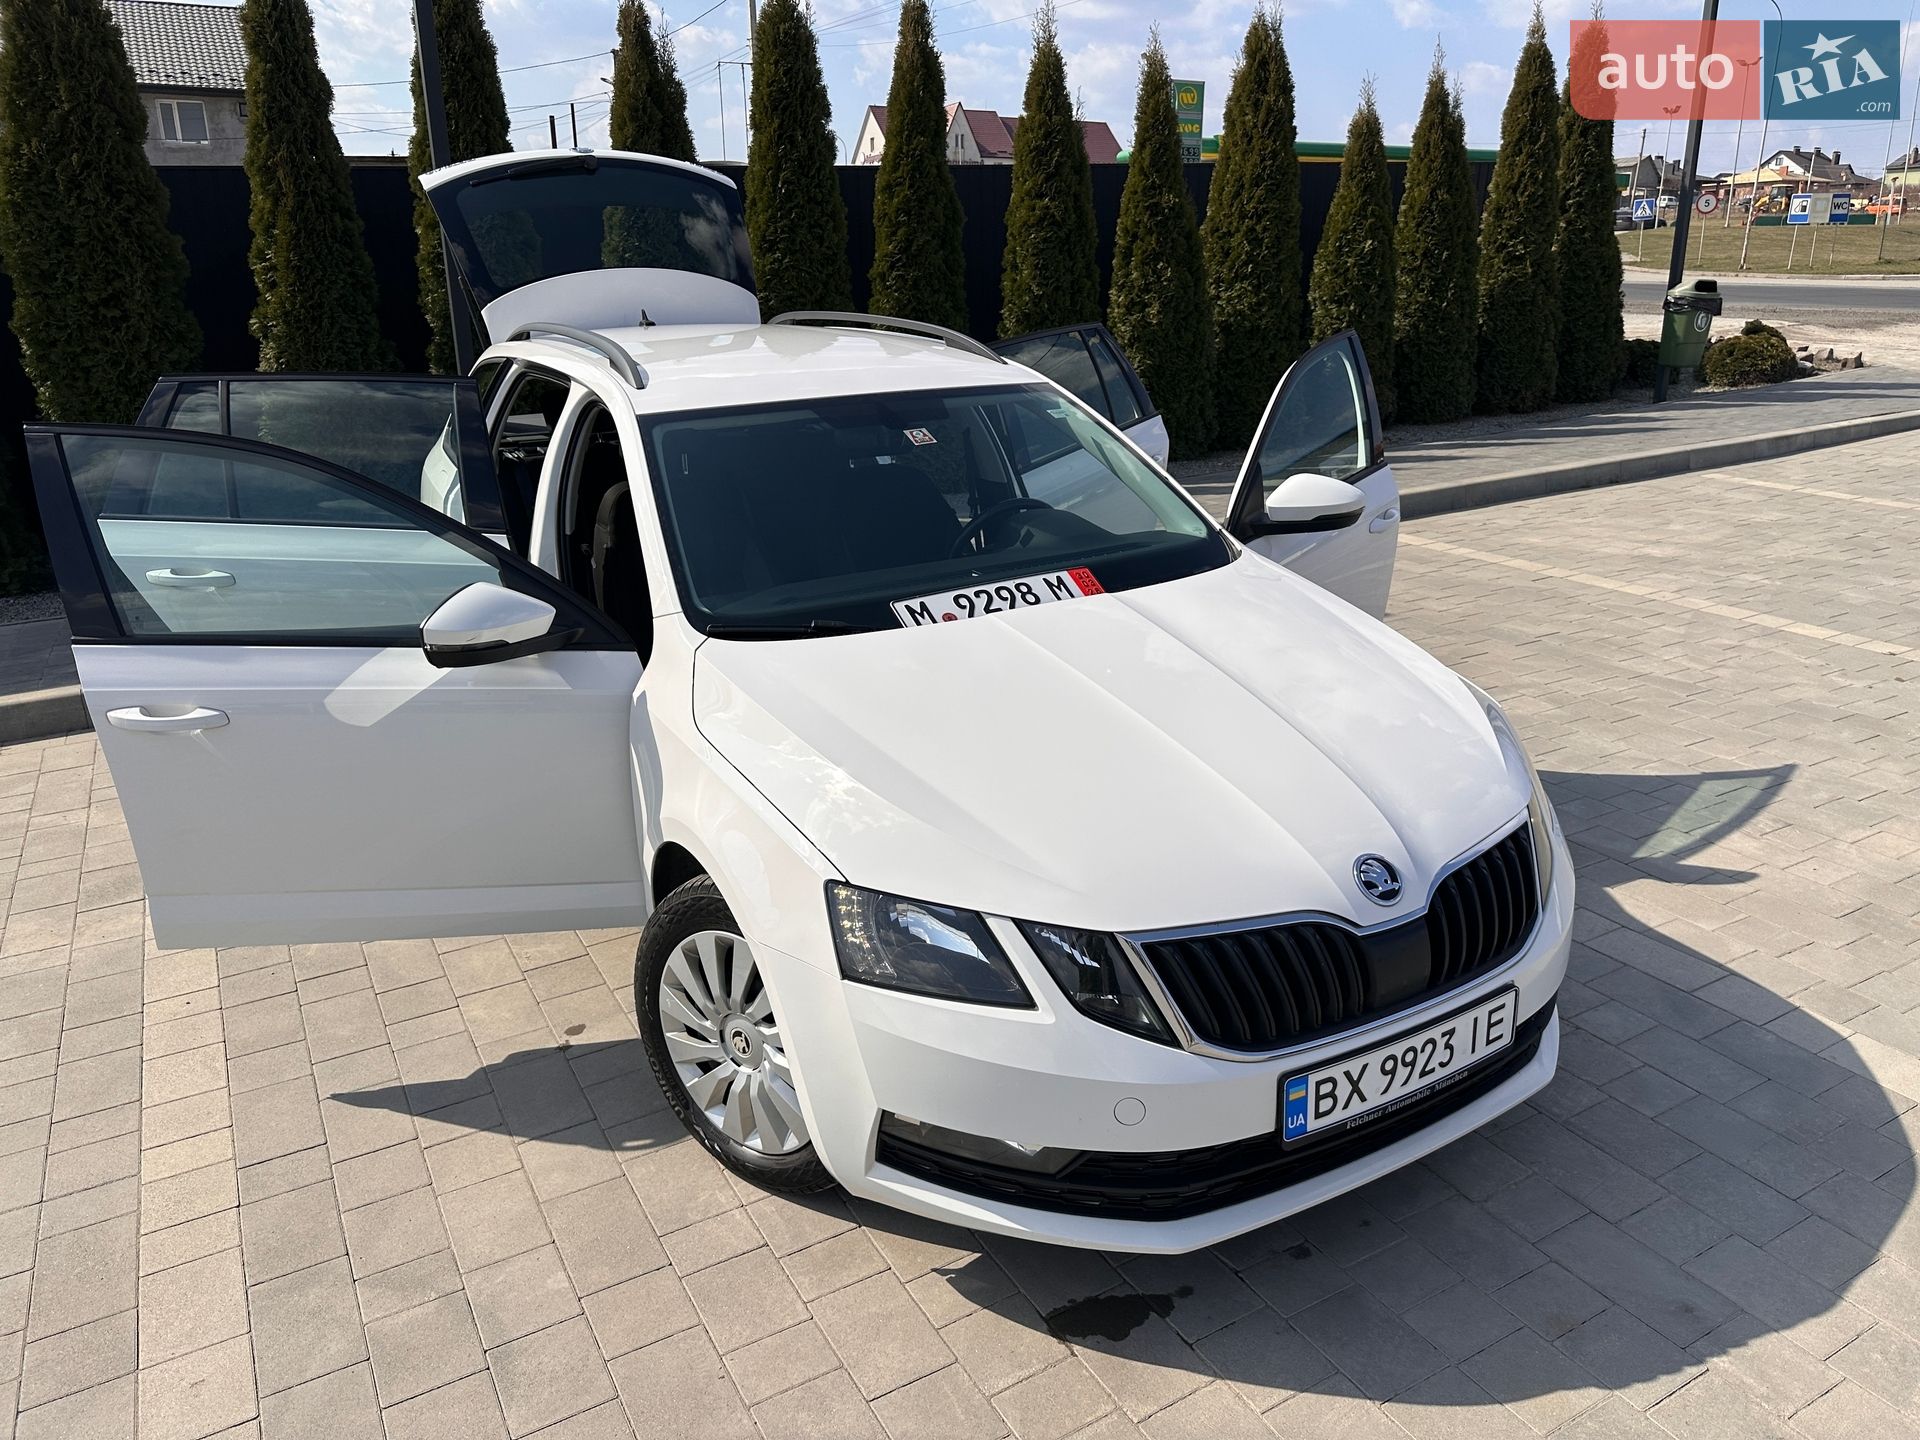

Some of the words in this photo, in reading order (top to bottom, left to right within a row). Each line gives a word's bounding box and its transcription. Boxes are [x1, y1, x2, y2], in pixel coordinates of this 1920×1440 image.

[1703, 200, 1710, 208] 5
[1833, 201, 1848, 210] WC
[903, 600, 938, 627] M
[952, 581, 1041, 618] 9298
[1041, 575, 1075, 601] M
[1313, 1062, 1370, 1121] BX
[1379, 1026, 1457, 1097] 9923
[1470, 1002, 1506, 1055] IE
[1385, 1088, 1432, 1114] Automobile
[1287, 1112, 1305, 1129] UA
